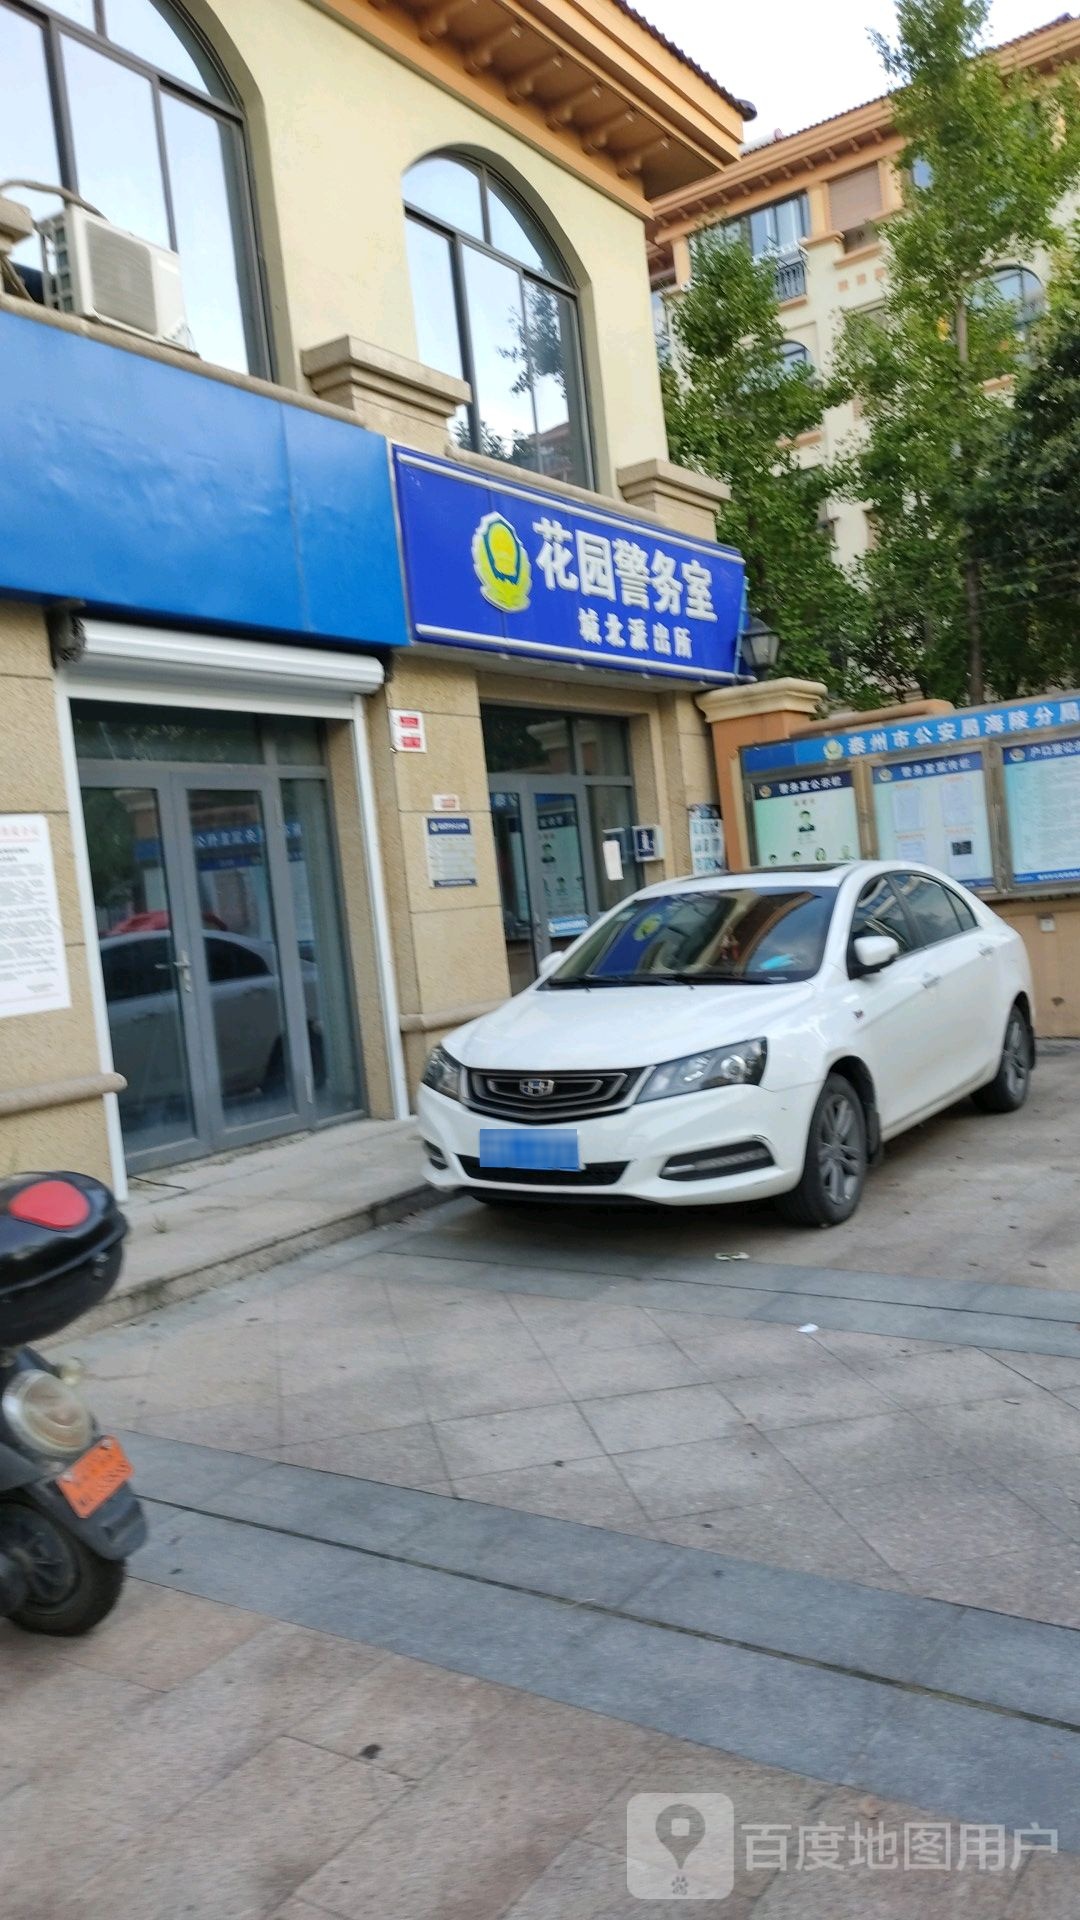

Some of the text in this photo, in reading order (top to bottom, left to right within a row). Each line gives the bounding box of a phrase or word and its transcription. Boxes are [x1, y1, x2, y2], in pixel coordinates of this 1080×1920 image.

[533, 517, 717, 622] 花园警务室
[578, 607, 693, 659] 城北派出所
[849, 701, 1080, 755] 泰州市公安局海陵分局
[779, 776, 842, 794] 警务室公示栏
